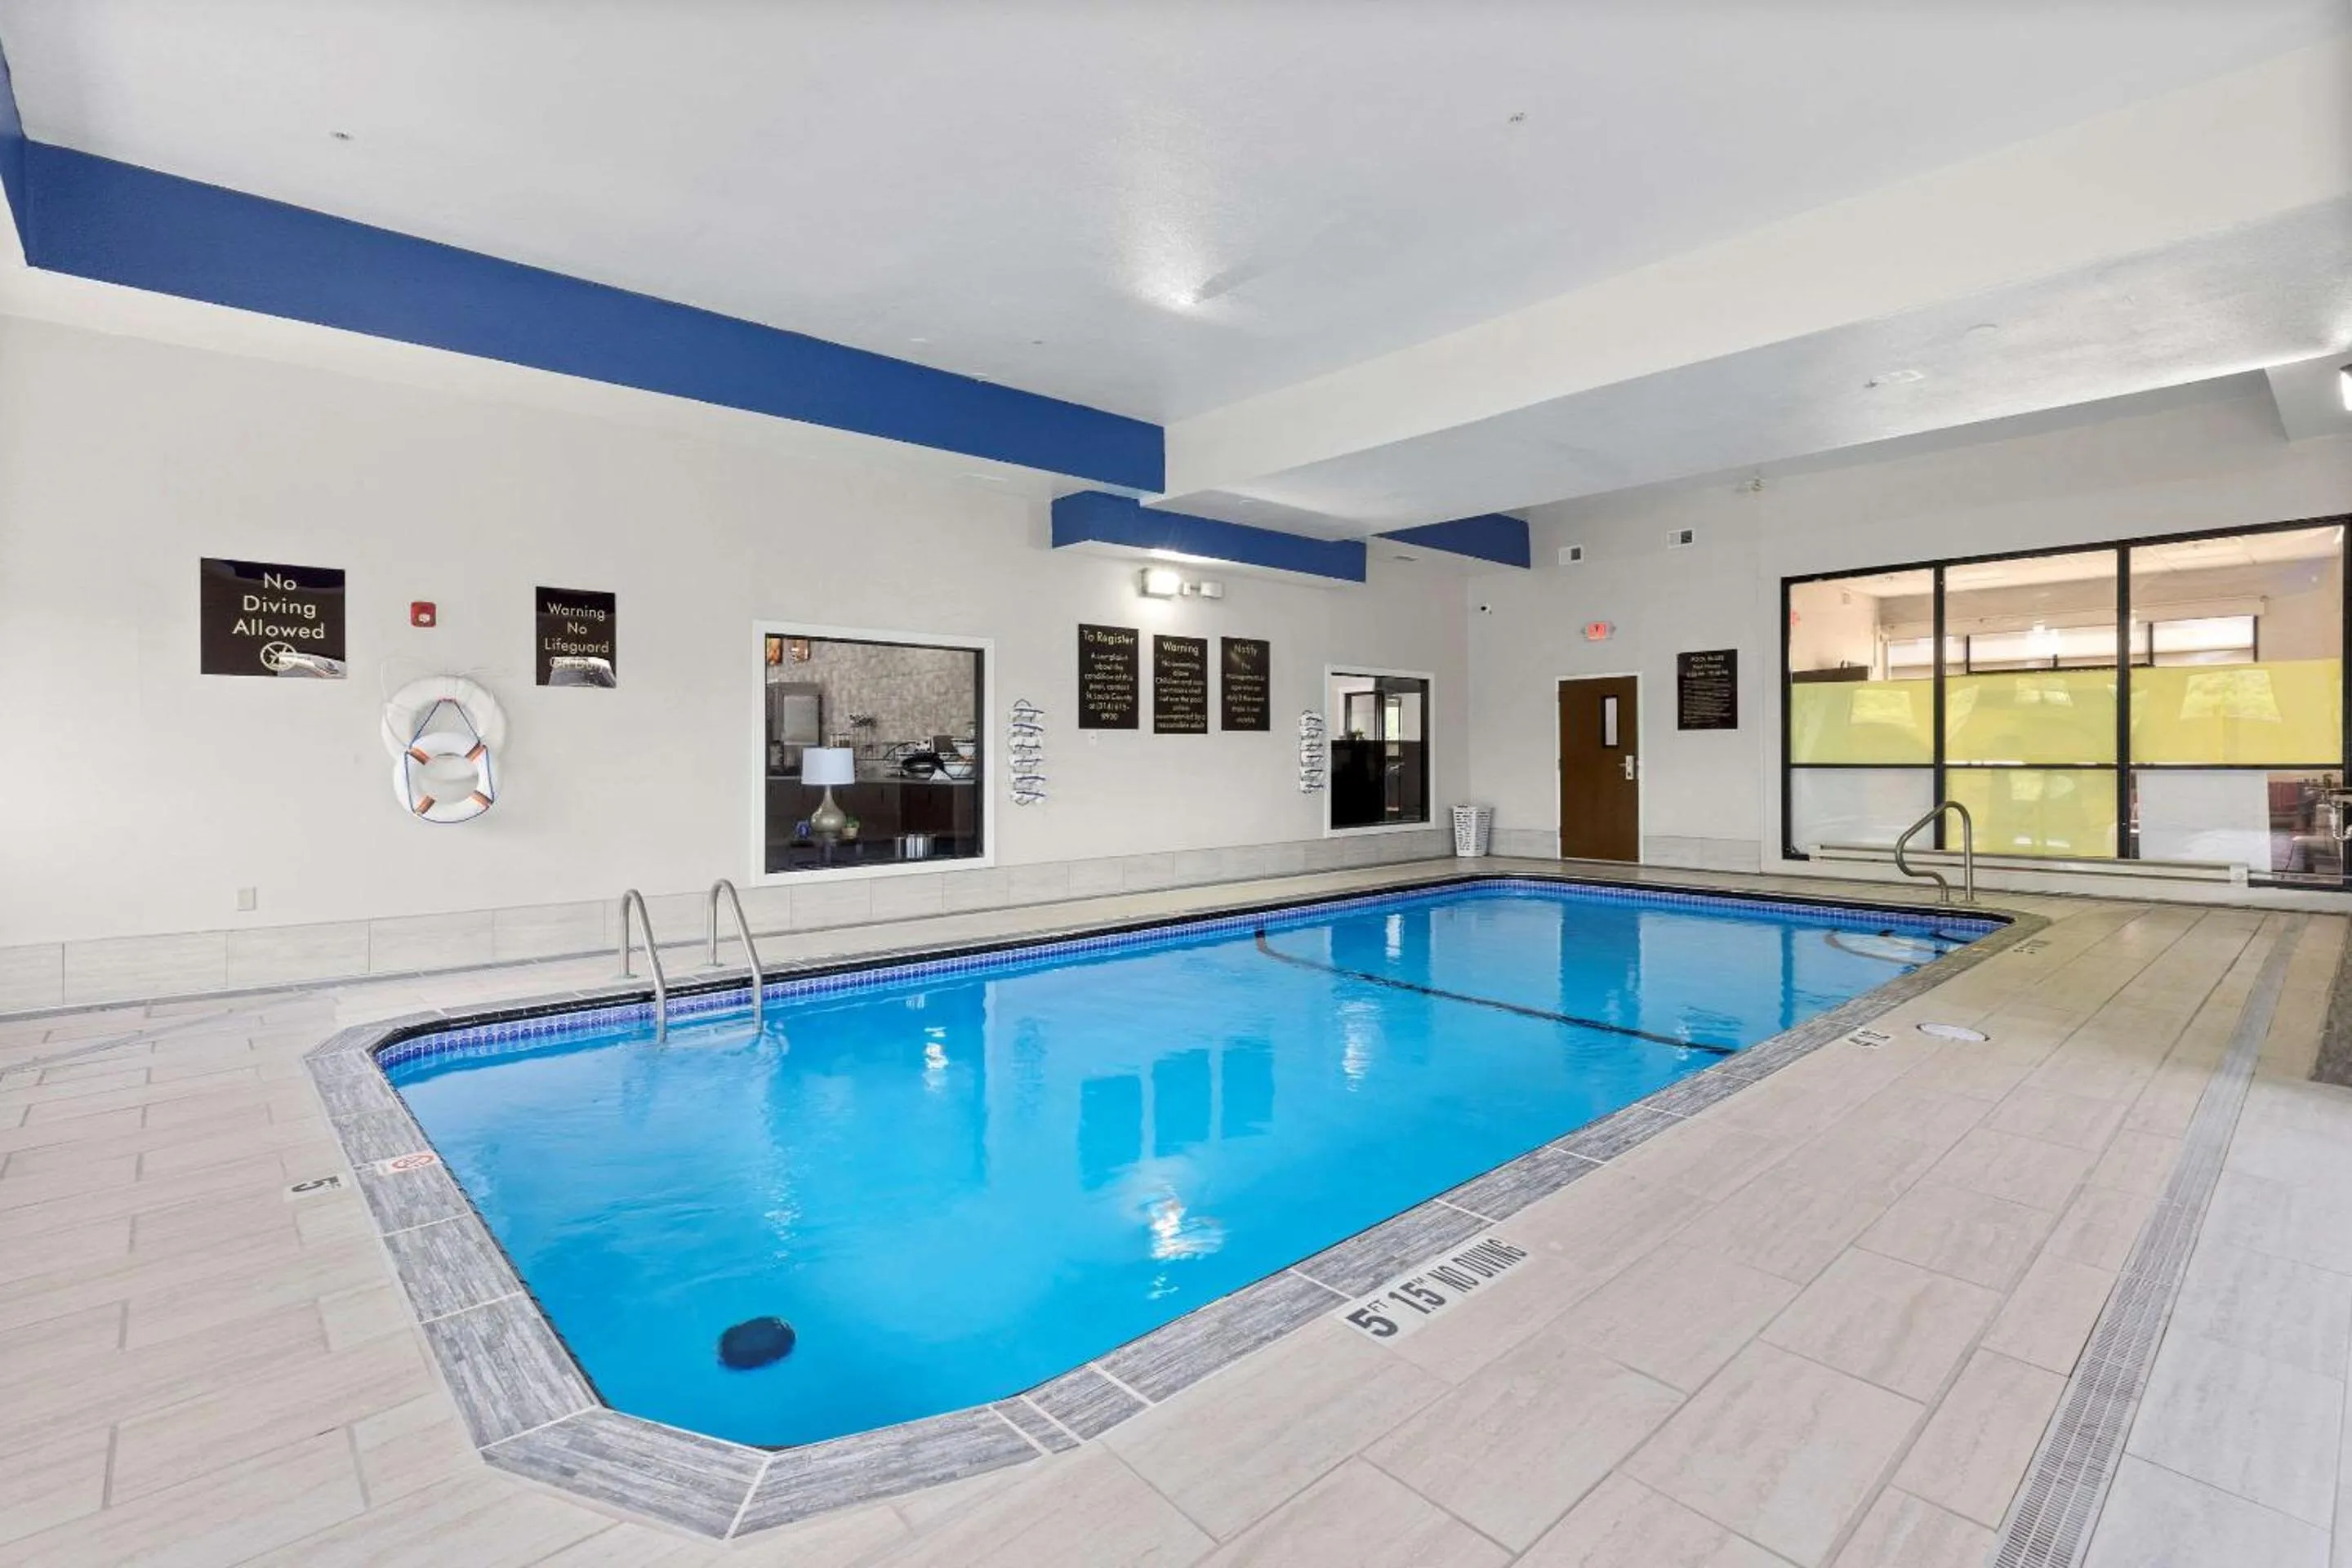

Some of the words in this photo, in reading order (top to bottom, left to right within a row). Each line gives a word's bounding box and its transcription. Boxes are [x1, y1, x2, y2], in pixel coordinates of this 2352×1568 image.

[264, 572, 297, 590] No
[243, 595, 317, 619] Diving
[547, 601, 605, 621] Warning
[232, 618, 324, 639] Allowed
[568, 621, 587, 635] No
[1083, 630, 1094, 643] To
[1097, 631, 1134, 645] Register
[545, 637, 609, 654] Lifeguard
[1163, 641, 1199, 657] Warning
[1451, 1238, 1528, 1278] DIVING
[1427, 1266, 1480, 1293] NO
